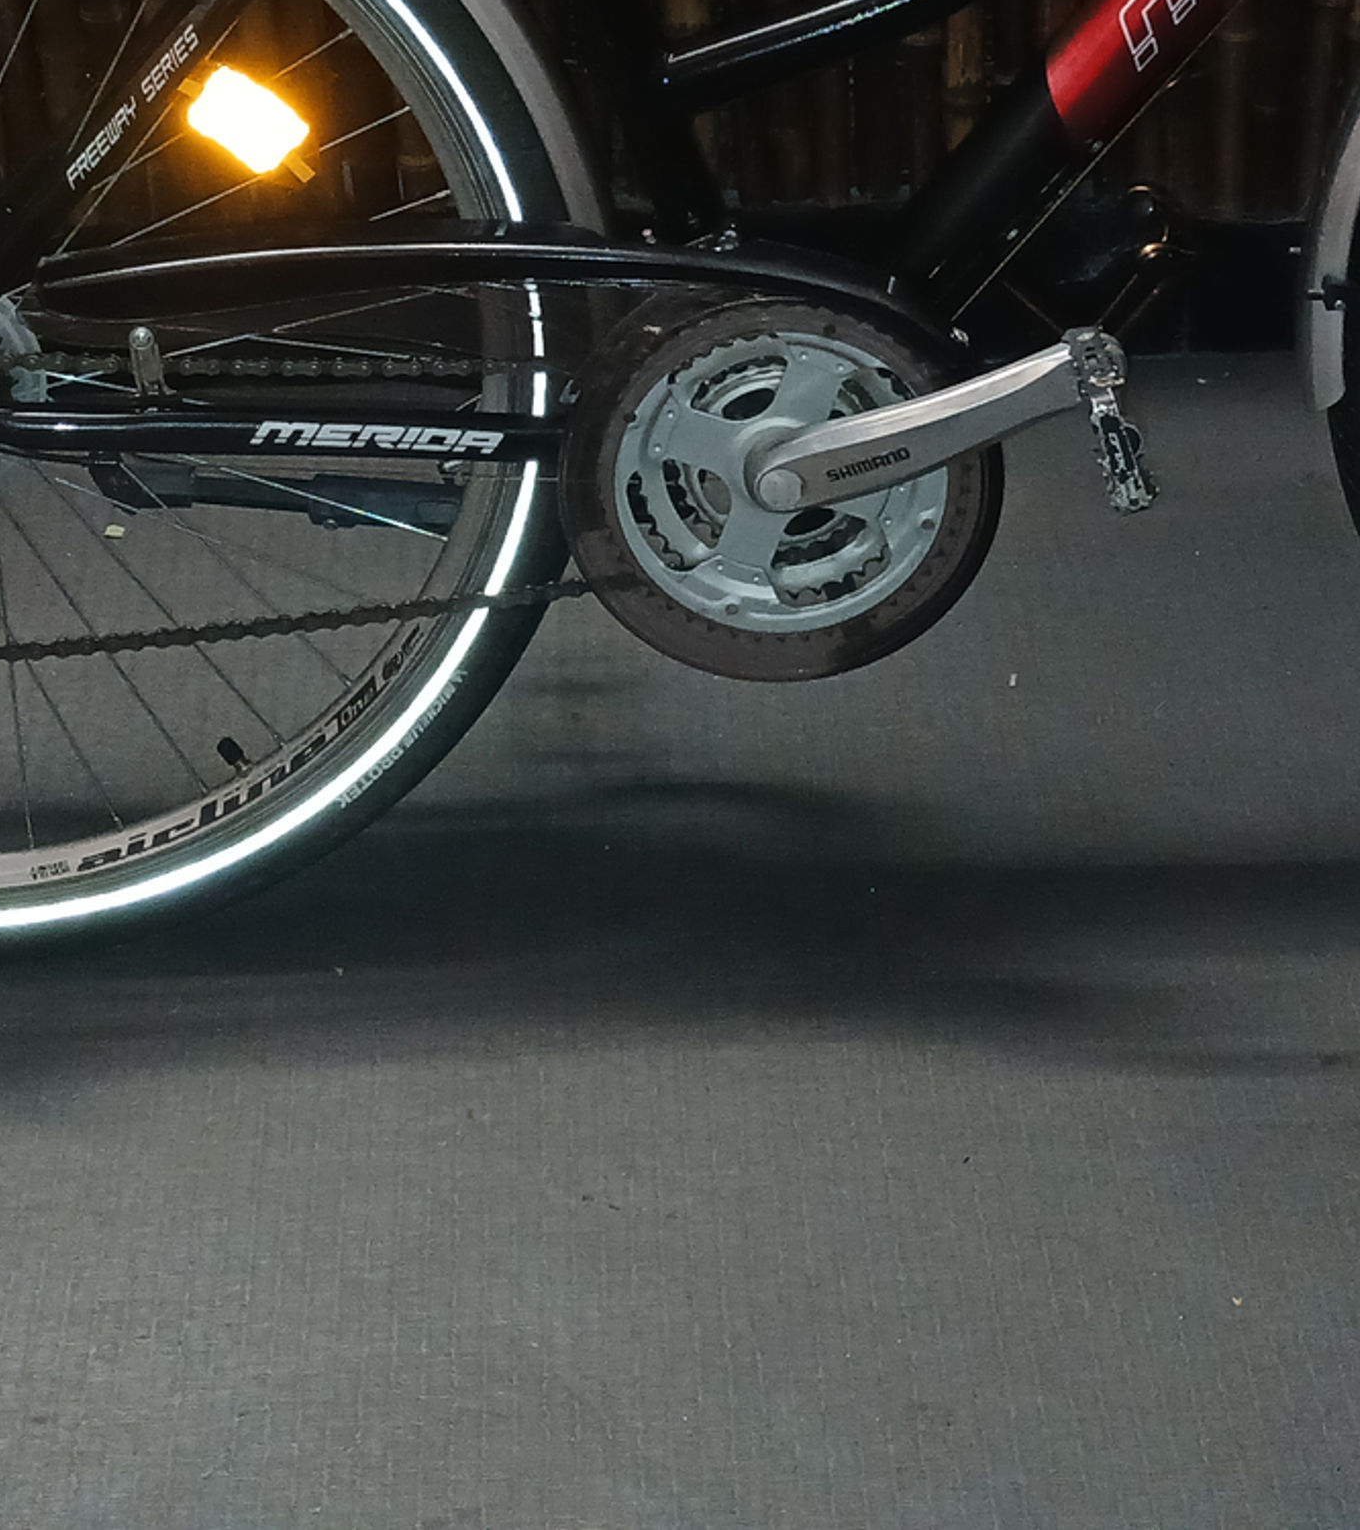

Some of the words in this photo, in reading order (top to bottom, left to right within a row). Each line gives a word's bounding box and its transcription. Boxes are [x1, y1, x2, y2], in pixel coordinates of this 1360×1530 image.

[65, 96, 137, 190] FREEWAY
[141, 23, 200, 103] SERIES
[250, 420, 504, 455] MERIDA
[826, 446, 911, 482] SHIMANO
